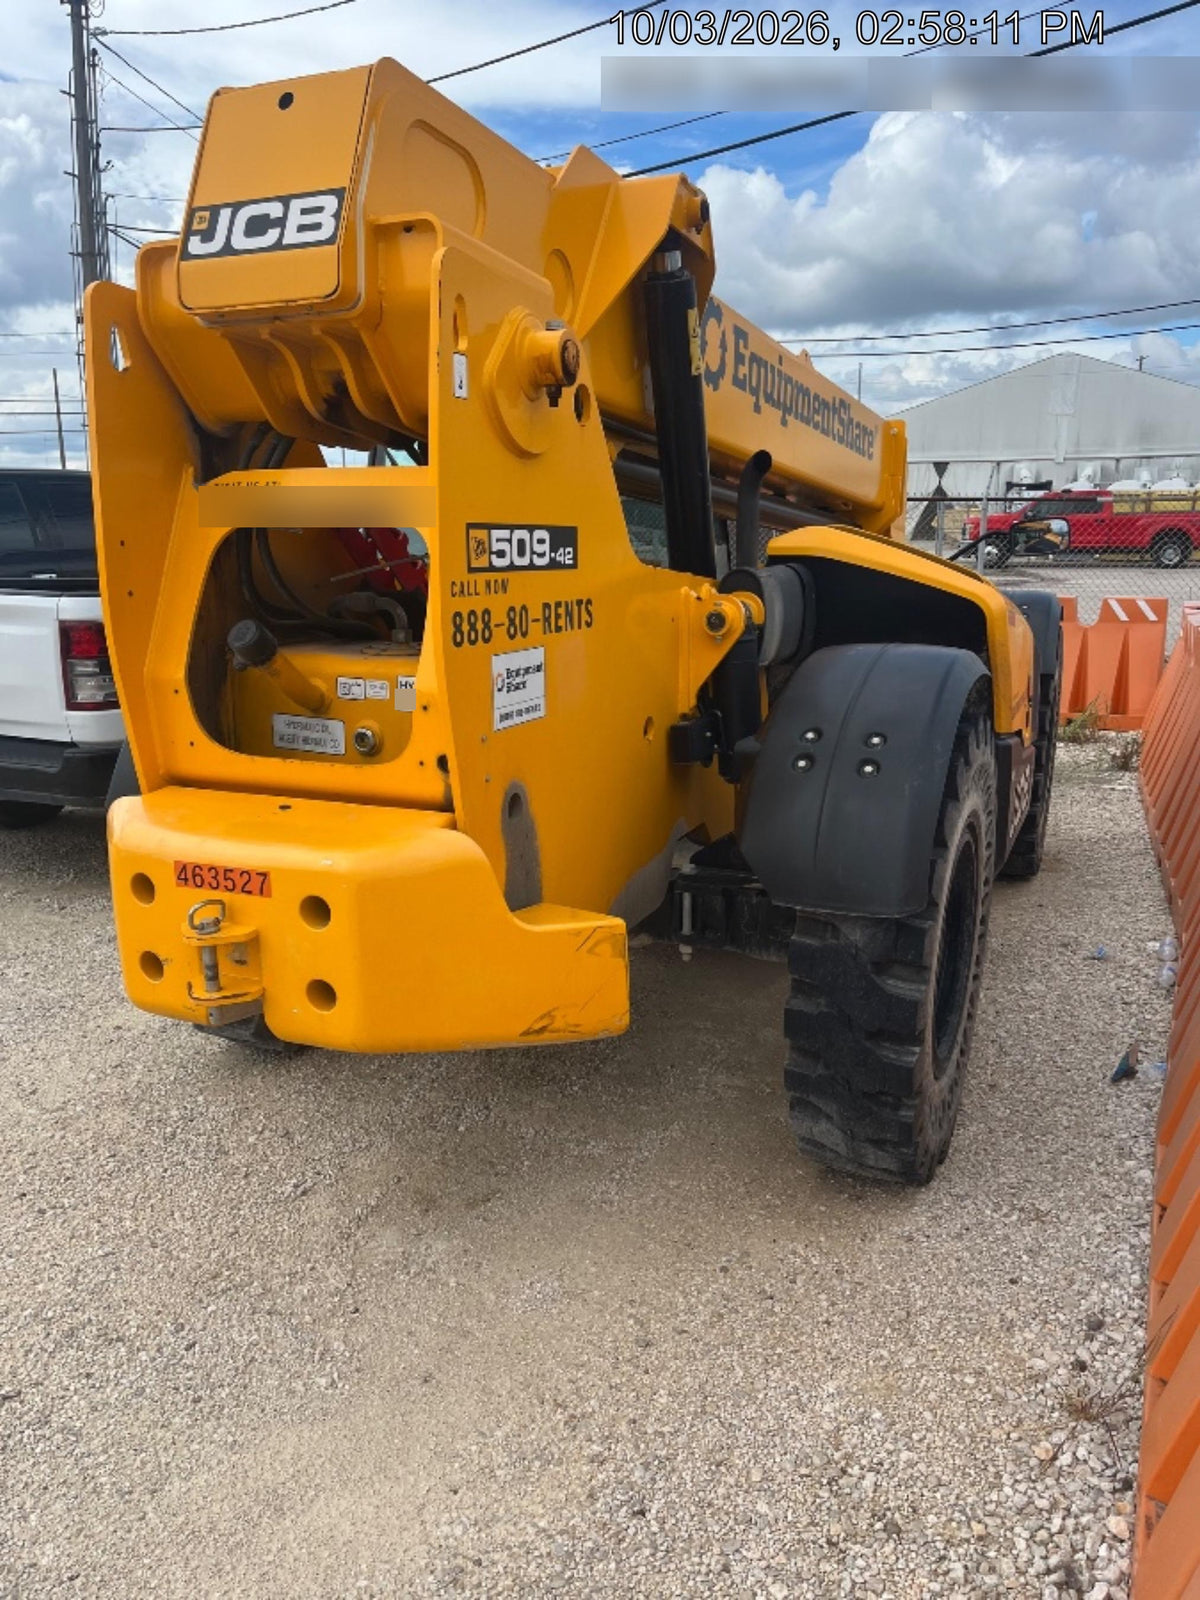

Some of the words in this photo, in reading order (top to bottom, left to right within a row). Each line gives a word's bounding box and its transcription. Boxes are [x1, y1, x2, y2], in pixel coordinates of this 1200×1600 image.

[187, 194, 339, 255] JCB
[731, 323, 874, 461] EquipmentShare
[451, 580, 480, 598] CALL
[485, 578, 509, 595] NOW
[452, 598, 593, 648] 888-80-RENTS
[177, 863, 268, 896] 463527
